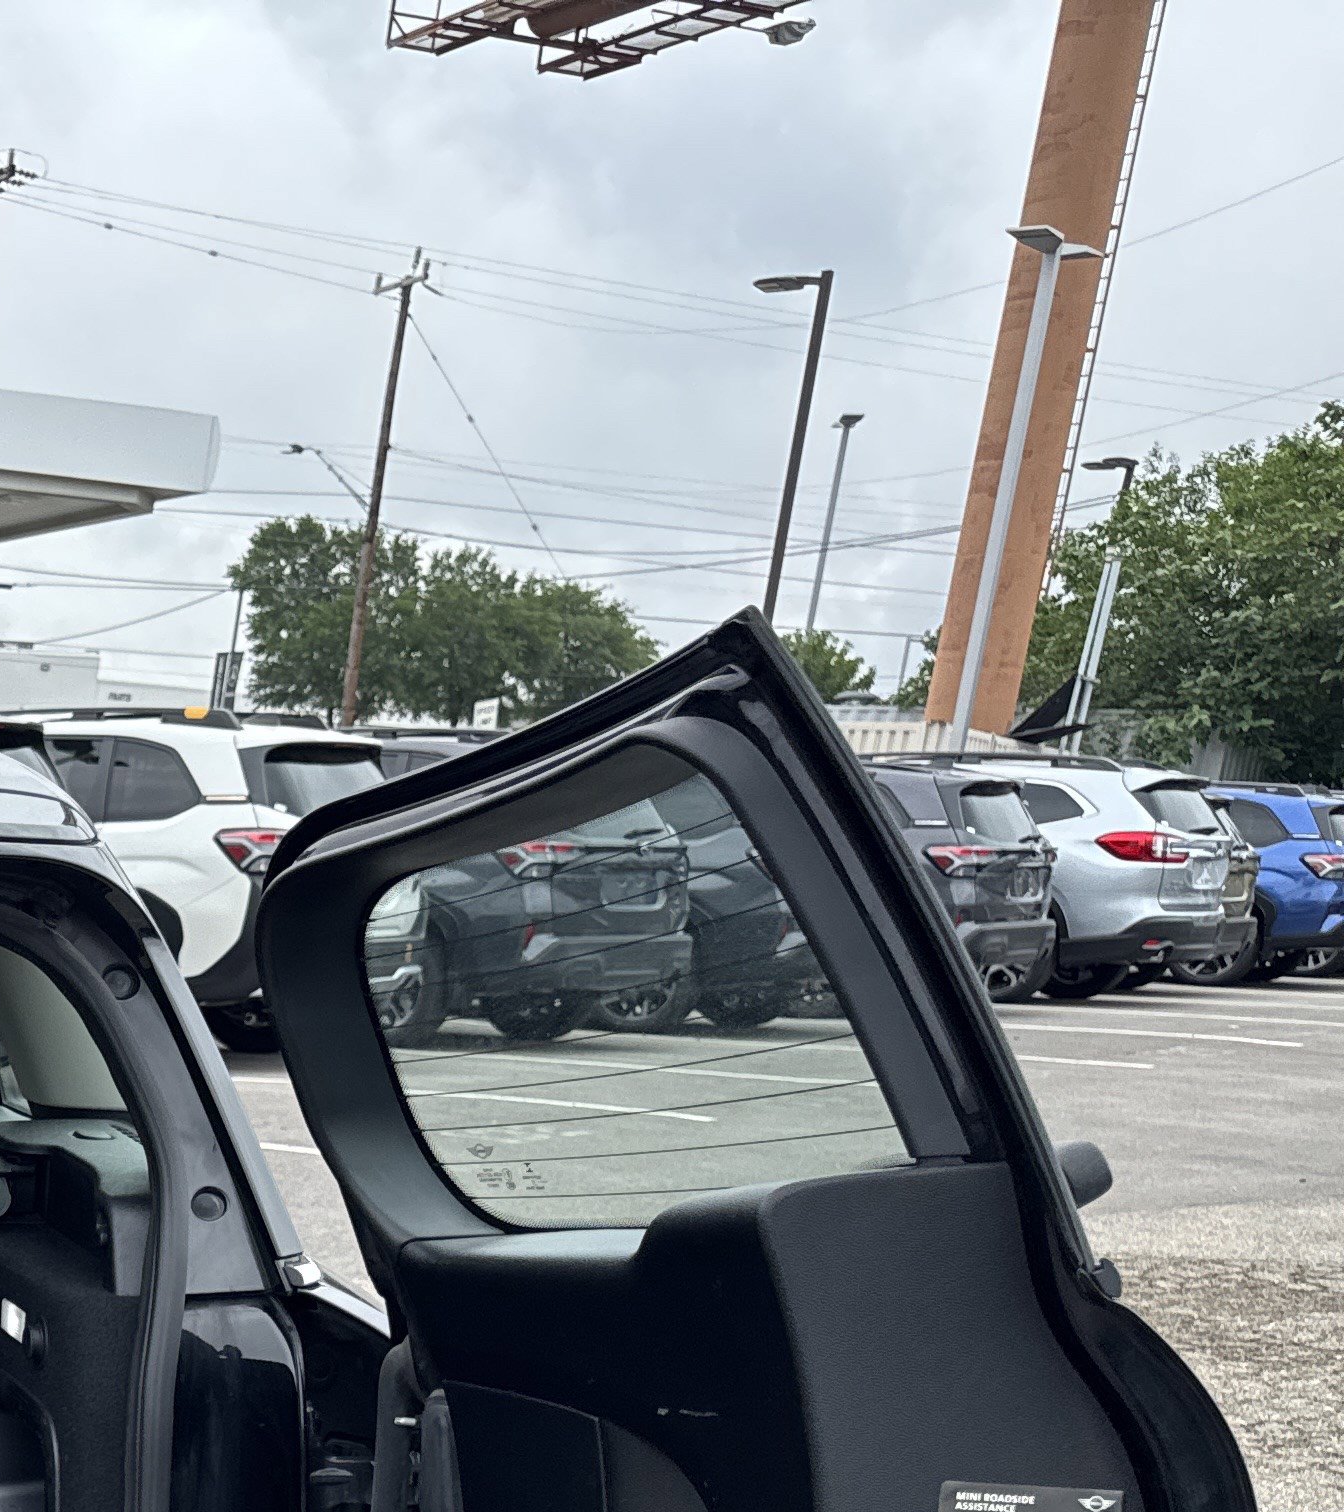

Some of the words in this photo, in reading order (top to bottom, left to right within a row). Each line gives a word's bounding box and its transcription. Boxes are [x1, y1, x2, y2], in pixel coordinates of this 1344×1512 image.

[956, 1491, 982, 1501] MINI
[984, 1493, 1035, 1504] ROADSIDE
[955, 1502, 1016, 1512] ASSISTANCE
